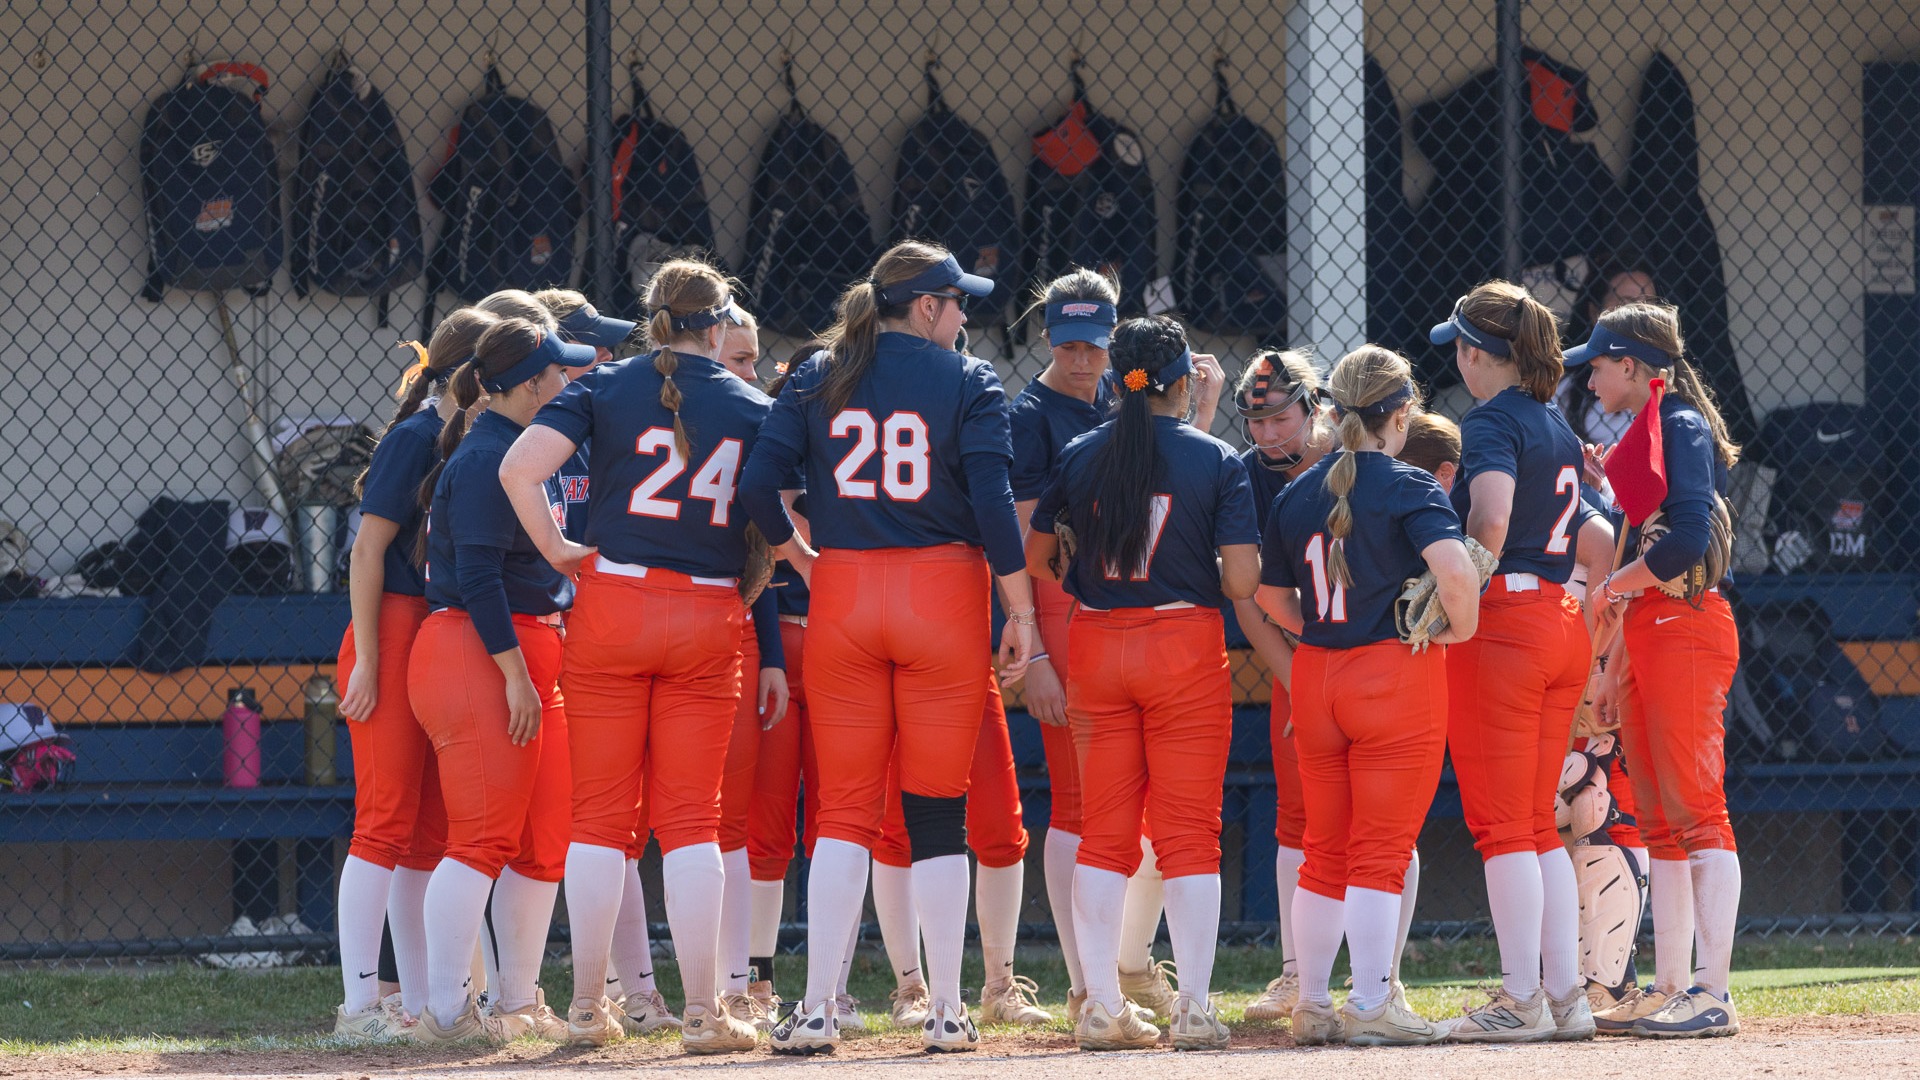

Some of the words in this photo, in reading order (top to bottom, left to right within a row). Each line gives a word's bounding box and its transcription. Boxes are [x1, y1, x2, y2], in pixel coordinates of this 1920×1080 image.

[627, 426, 743, 527] 24
[829, 408, 931, 502] 28
[1544, 465, 1580, 555] 2
